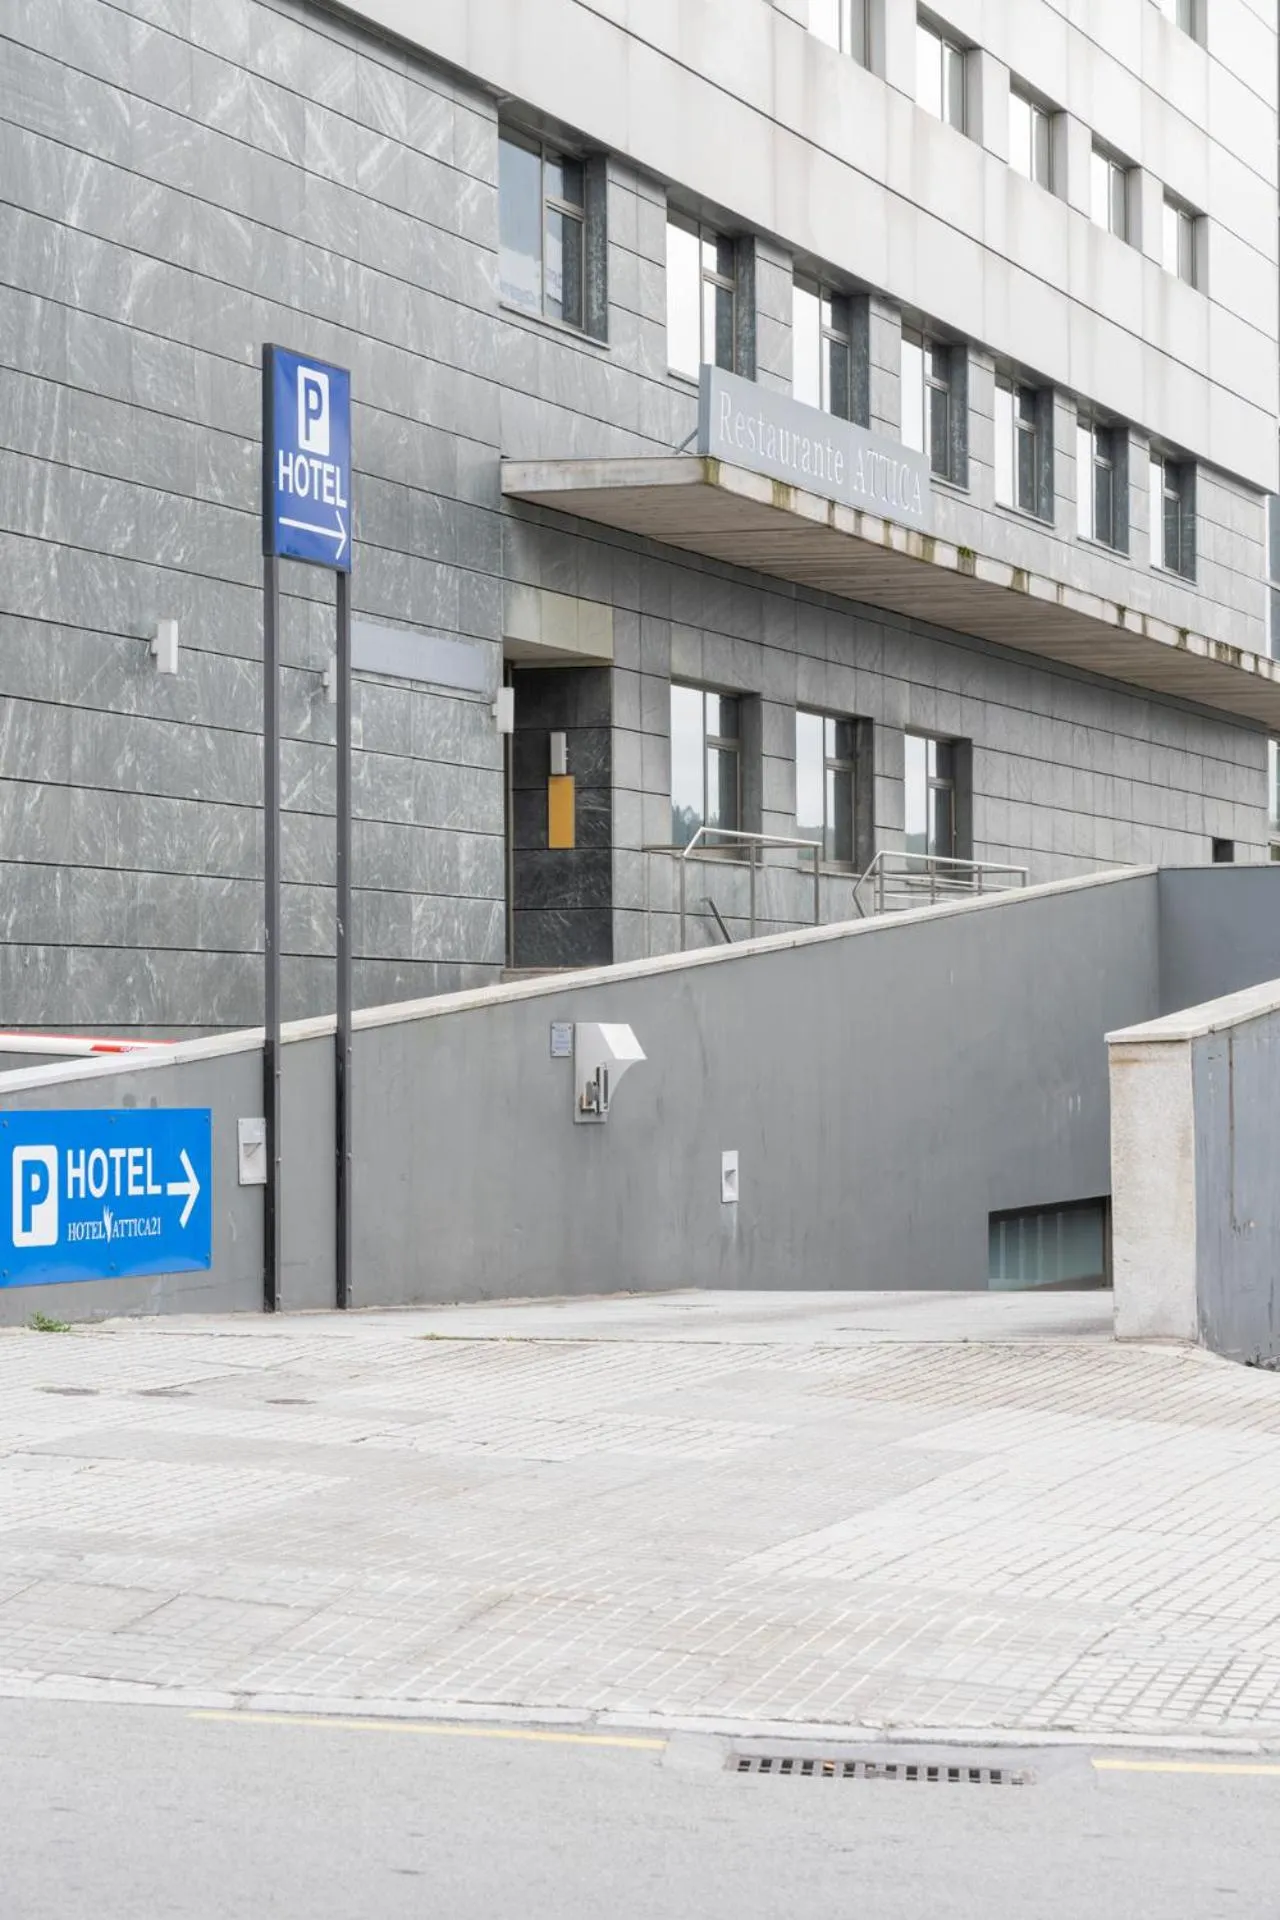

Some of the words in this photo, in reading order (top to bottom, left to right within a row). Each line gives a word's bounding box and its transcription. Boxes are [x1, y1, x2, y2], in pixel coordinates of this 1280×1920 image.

[303, 377, 323, 441] P
[278, 449, 348, 508] HOTEL
[719, 391, 844, 485] Restaurante
[853, 447, 923, 515] ATTICA
[21, 1159, 50, 1233] P
[66, 1147, 163, 1199] HOTEL
[67, 1220, 106, 1241] HOTEL
[112, 1217, 161, 1238] ATTICA21
